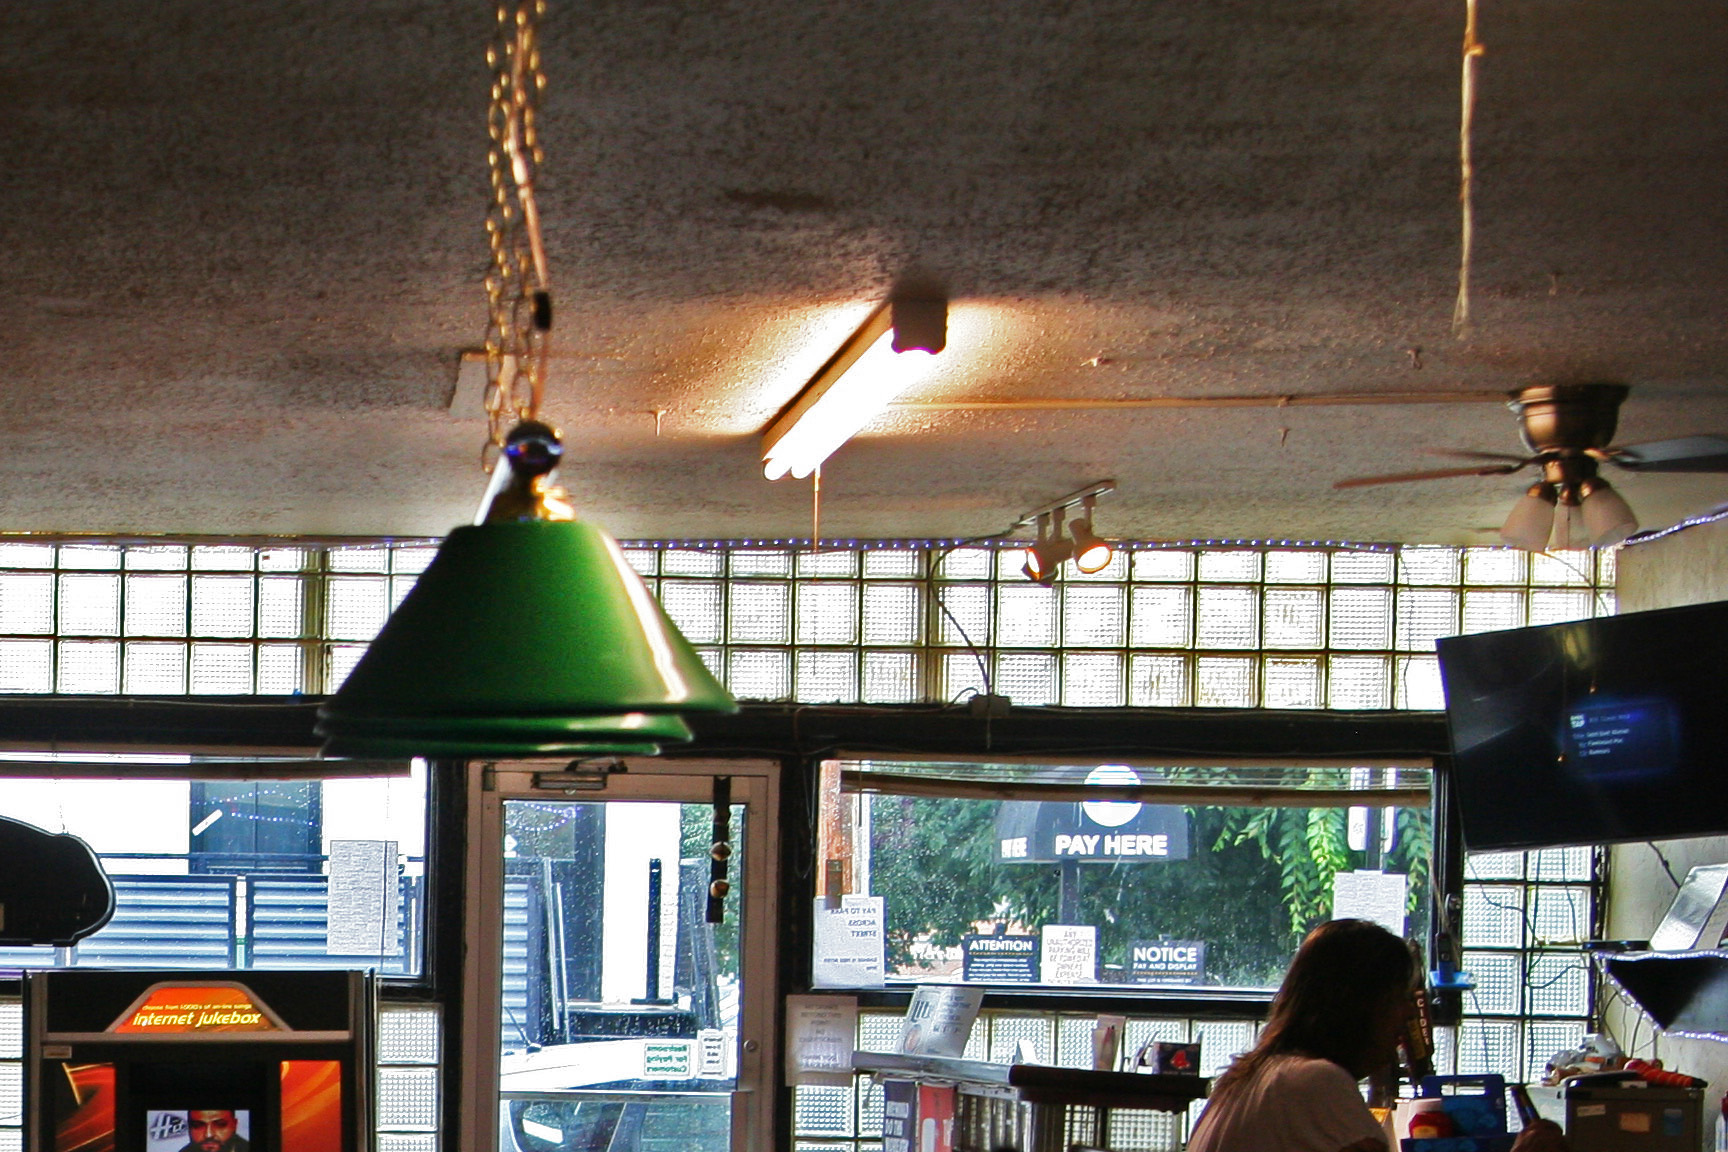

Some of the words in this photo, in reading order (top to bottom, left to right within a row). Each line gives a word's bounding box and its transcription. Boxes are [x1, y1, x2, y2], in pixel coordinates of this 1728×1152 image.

[1055, 834, 1100, 855] PAY
[1104, 834, 1168, 856] HERE
[969, 940, 1032, 951] ATTENTION
[1133, 946, 1197, 962] NOTICE
[132, 1012, 195, 1026] internet
[195, 1011, 261, 1028] jukebox
